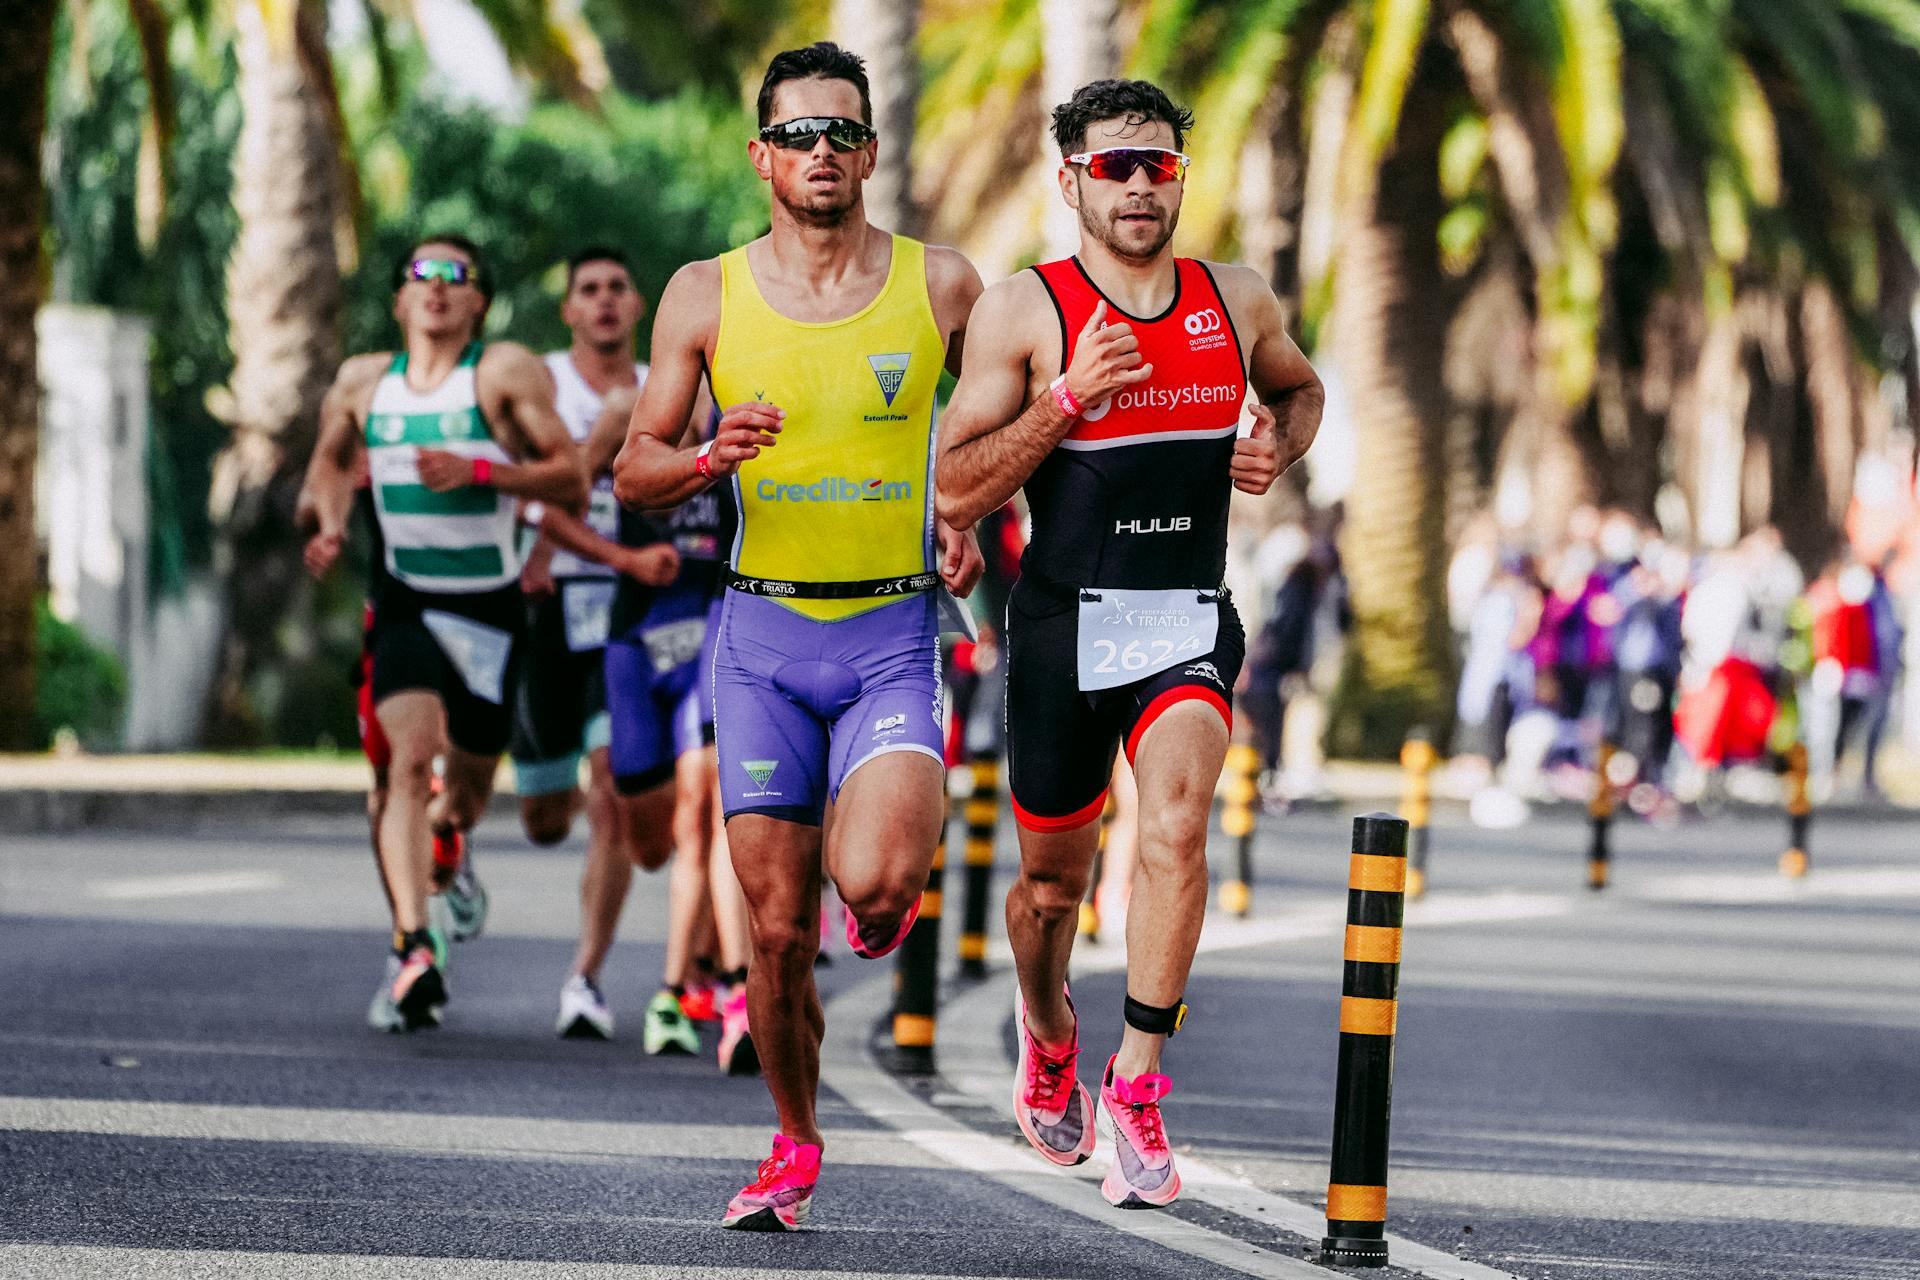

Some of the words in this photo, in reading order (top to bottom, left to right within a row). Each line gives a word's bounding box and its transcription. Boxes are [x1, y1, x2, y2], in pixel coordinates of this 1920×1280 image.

[1118, 383, 1237, 411] outsystems
[757, 477, 912, 502] Credibom
[1115, 517, 1192, 534] HUUB
[761, 584, 796, 595] TRIATLO
[910, 577, 937, 588] TRIATLO
[1137, 616, 1190, 627] TRIATLO
